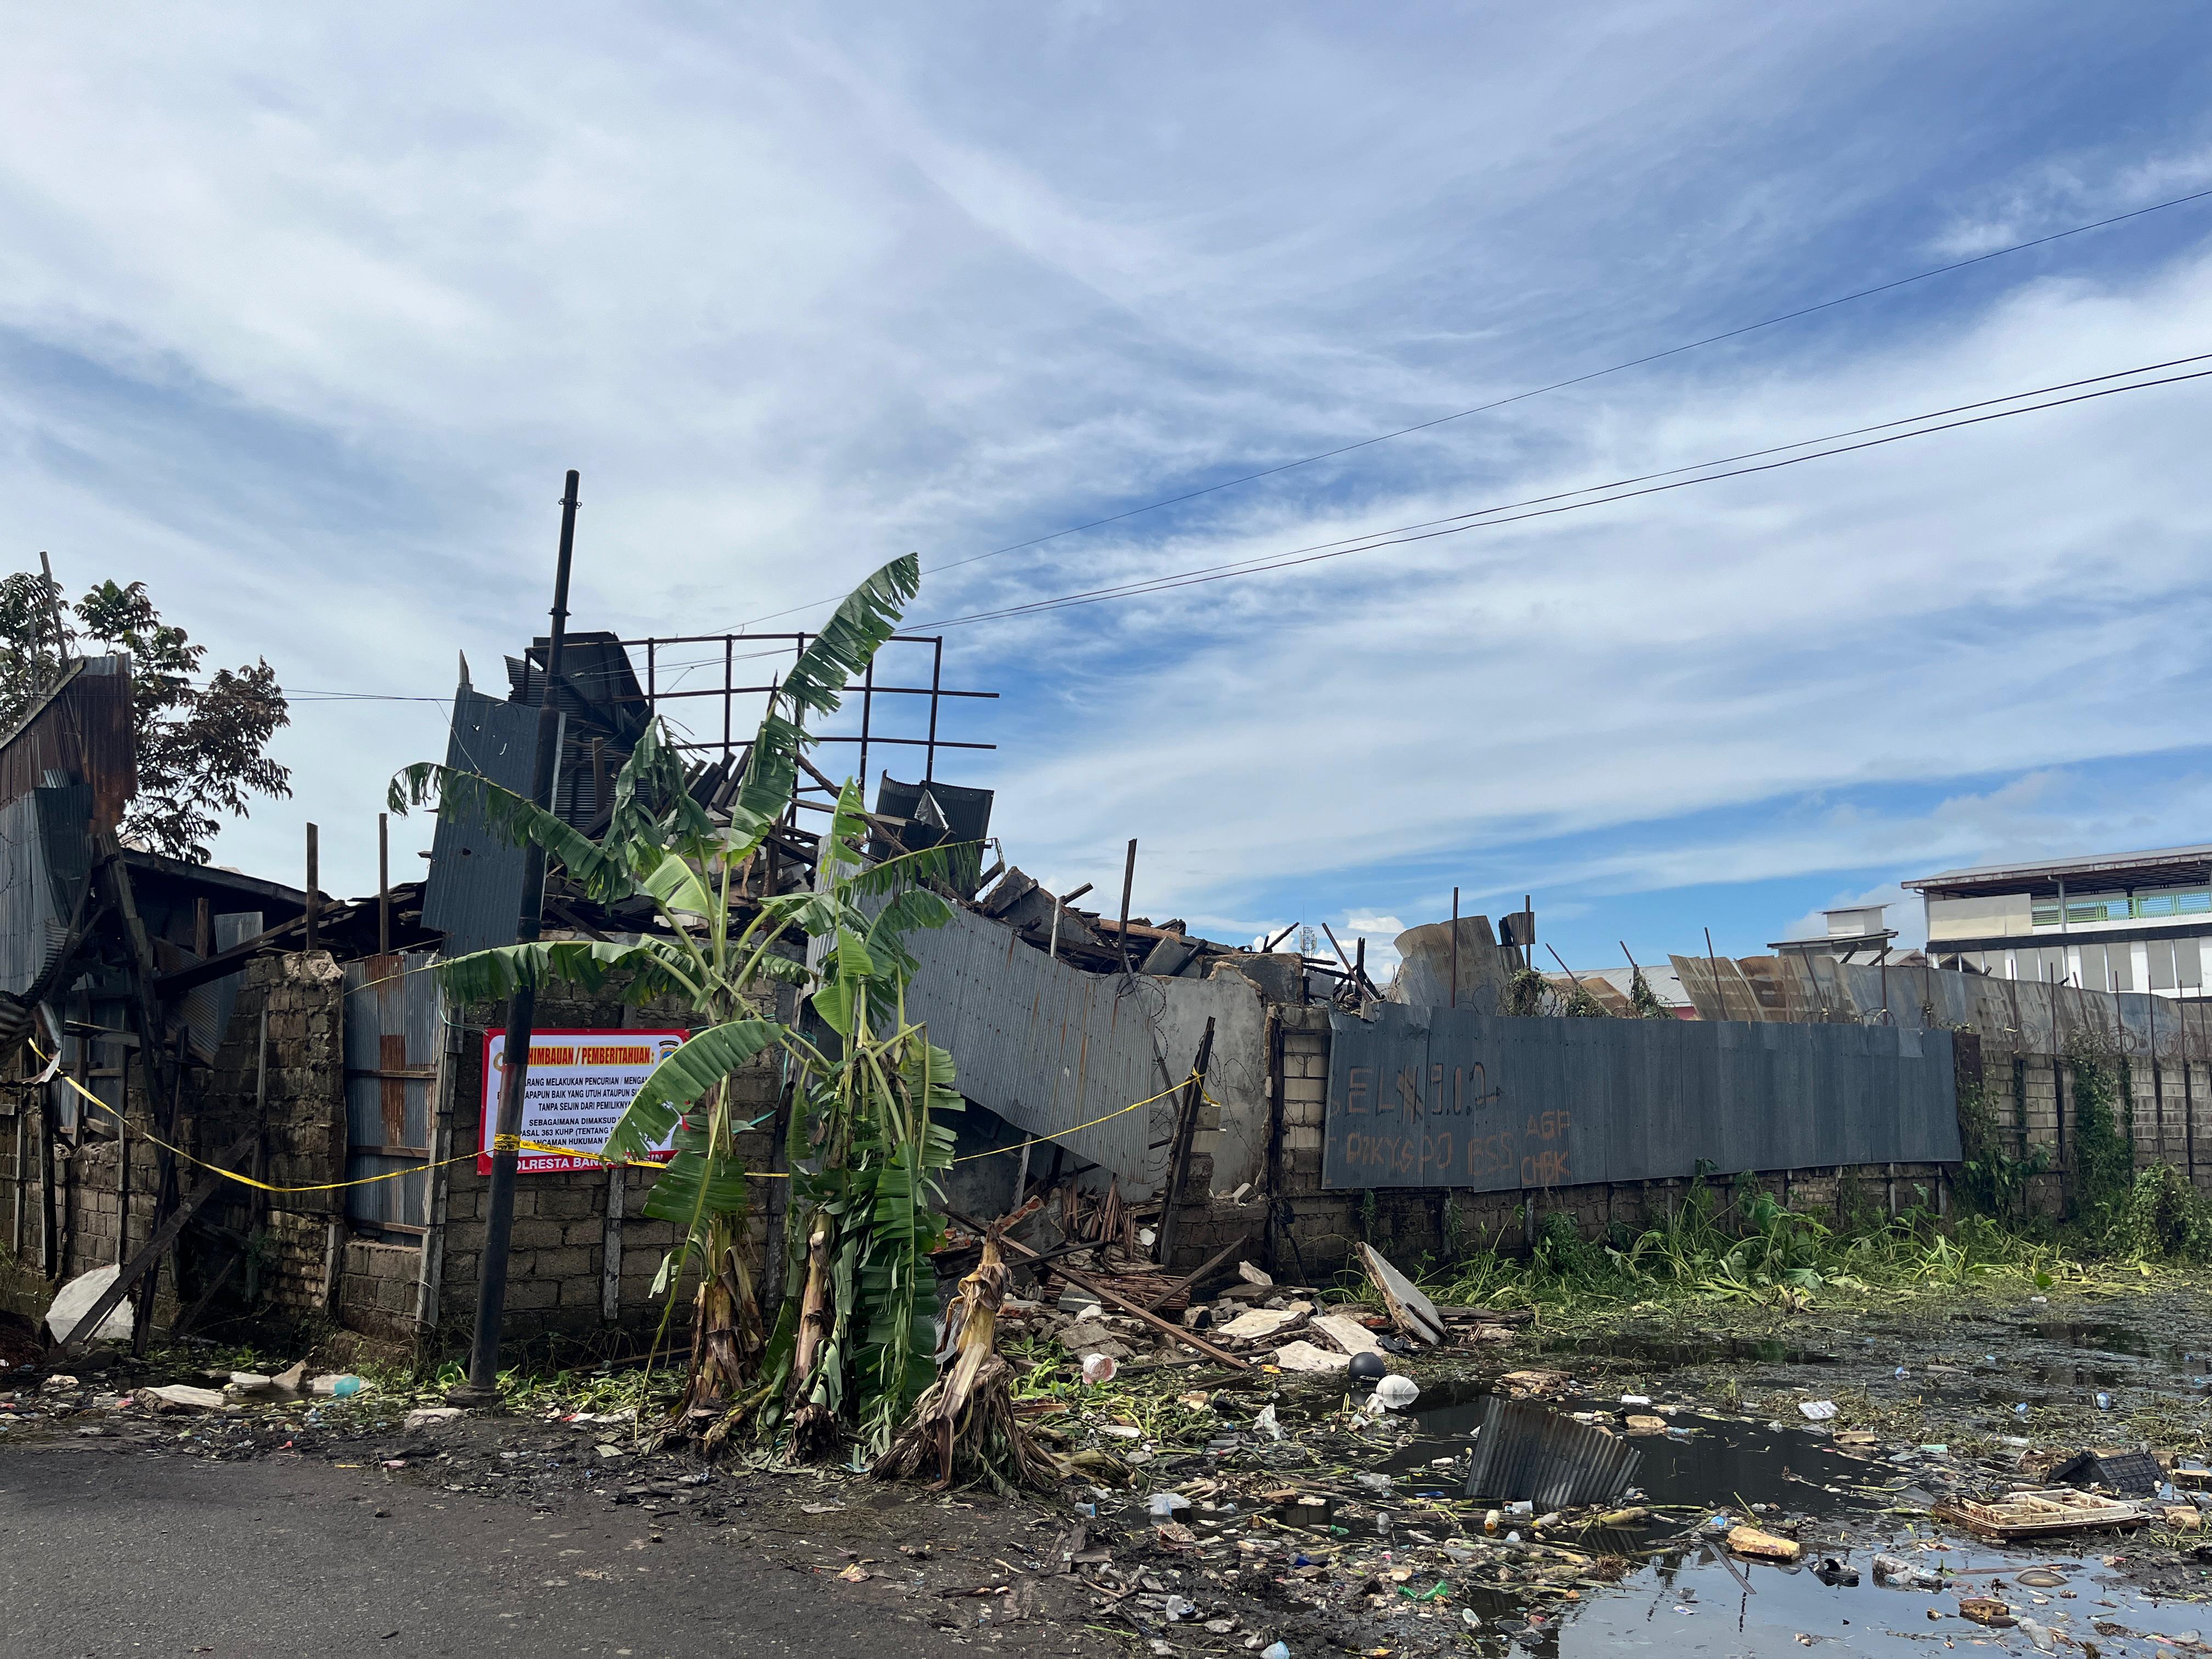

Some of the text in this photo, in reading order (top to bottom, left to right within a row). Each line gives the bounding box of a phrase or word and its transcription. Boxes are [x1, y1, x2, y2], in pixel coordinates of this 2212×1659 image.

[582, 1047, 651, 1064] PEMBERITAHUAN
[526, 1077, 544, 1086] RANG
[546, 1077, 583, 1086] MELAKUKAN
[585, 1077, 619, 1085] PENCURIAN
[525, 1091, 550, 1099] APAPUN
[551, 1090, 566, 1098] BAIK
[568, 1090, 584, 1098] YANG
[585, 1089, 601, 1098] UTUH
[603, 1088, 630, 1097] ATAUPUN
[560, 1102, 579, 1110] SEIJIN
[580, 1102, 595, 1110] DARI
[529, 1118, 579, 1126] SEBAGAIMANA
[575, 1127, 609, 1136] (TENTANG
